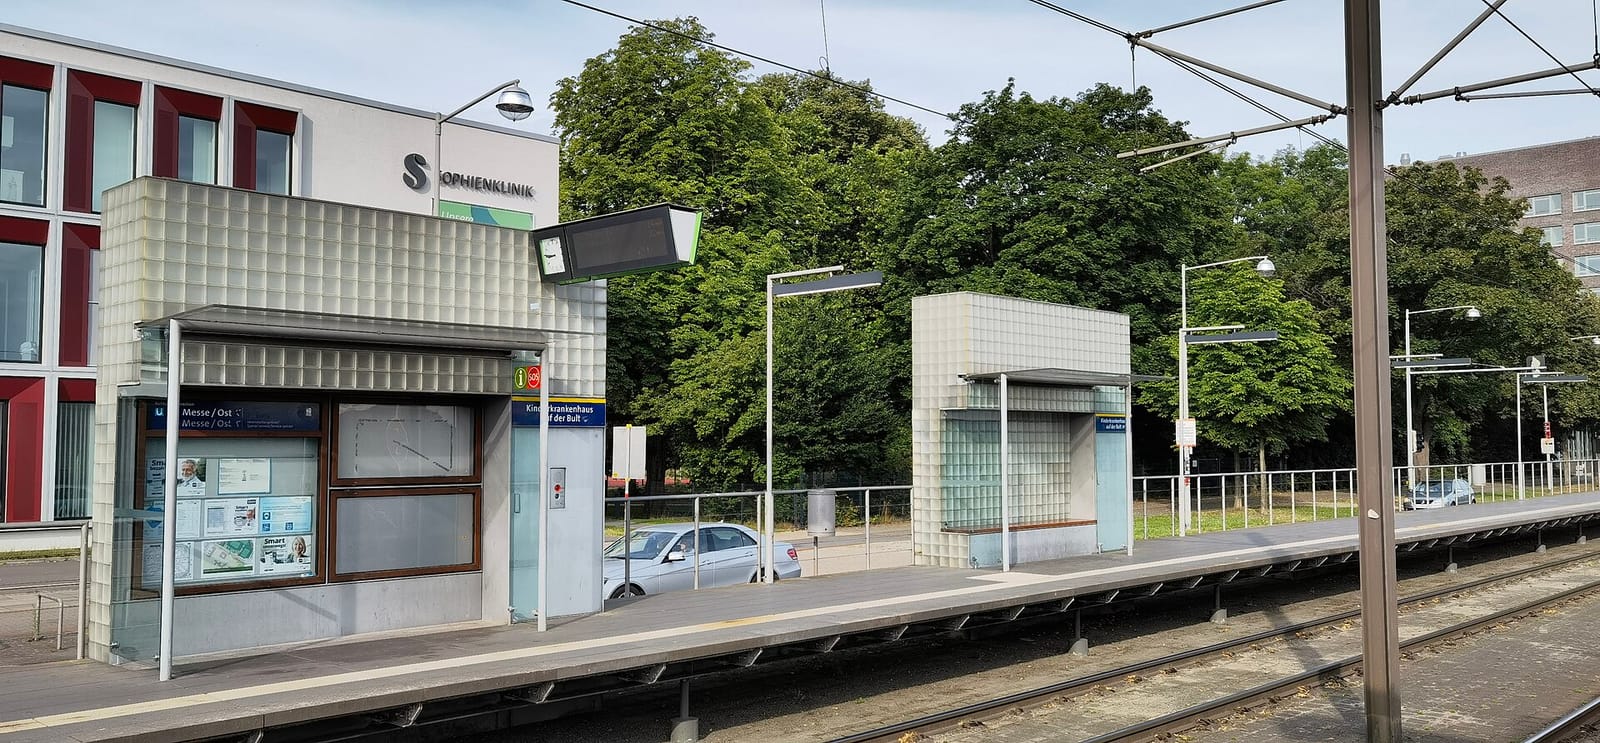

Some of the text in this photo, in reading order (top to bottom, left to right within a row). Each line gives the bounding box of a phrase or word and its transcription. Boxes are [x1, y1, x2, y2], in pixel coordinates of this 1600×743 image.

[528, 373, 539, 382] SOS
[182, 408, 210, 417] Messe
[218, 408, 232, 417] Ost
[526, 404, 594, 414] Kinkrankenhaus
[554, 414, 565, 422] der
[566, 414, 581, 423] Bult
